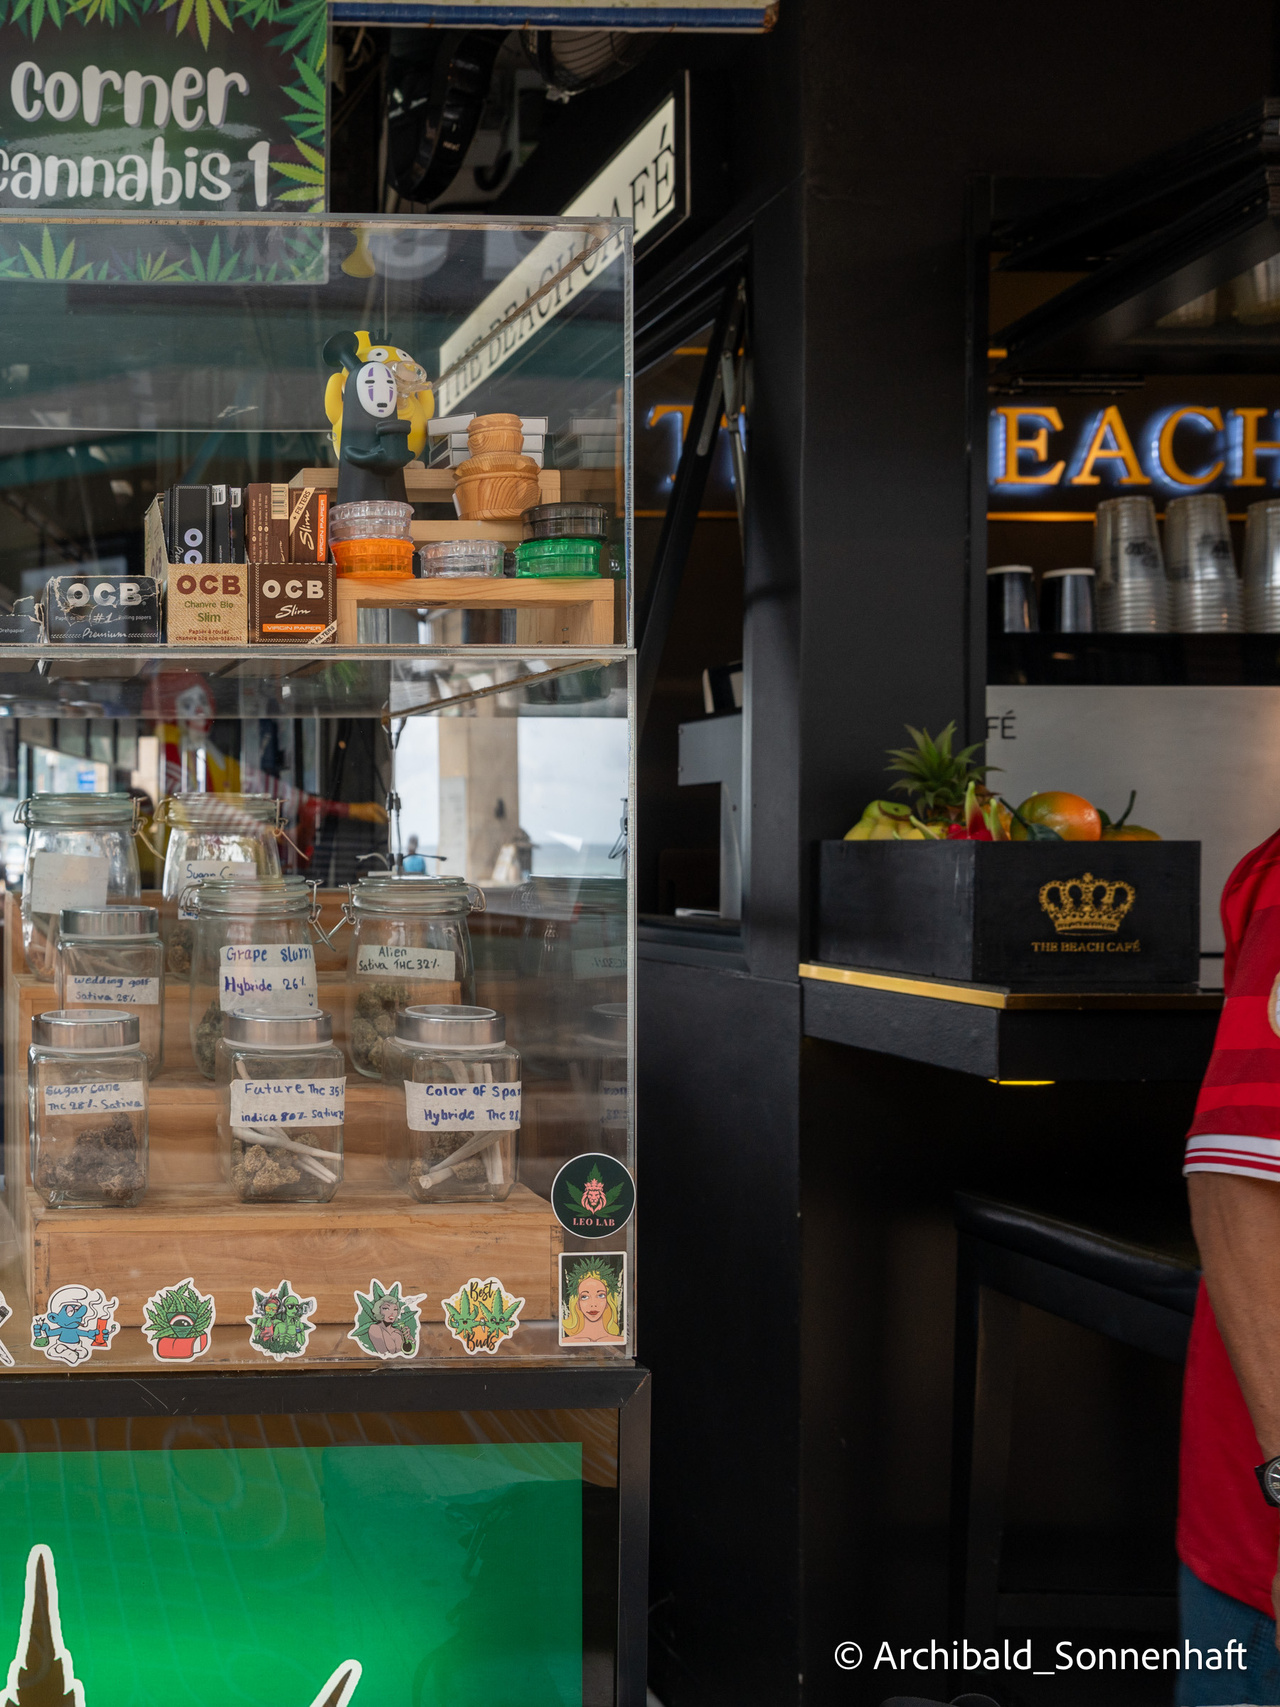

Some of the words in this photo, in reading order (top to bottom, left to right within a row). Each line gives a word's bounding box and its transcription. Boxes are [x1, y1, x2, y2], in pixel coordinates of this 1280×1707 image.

[247, 140, 270, 206] 1
[995, 405, 1280, 486] EACH
[295, 490, 311, 515] FILTERS
[299, 510, 315, 551] Slim
[176, 575, 241, 595] OCB
[262, 579, 324, 599] OCB
[66, 582, 142, 607] OCB
[184, 600, 217, 608] Chanvre
[220, 601, 234, 609] Bio
[275, 604, 311, 619] Slim
[198, 612, 221, 623] Slim
[81, 628, 127, 639] Premium
[315, 625, 336, 643] FILTERS
[226, 947, 267, 962] Grape
[378, 946, 407, 957] Alien
[1031, 942, 1058, 952] THE
[1060, 942, 1105, 952] BEACH
[1106, 939, 1141, 953] CAFÉ
[225, 976, 272, 996] Hybride
[244, 1083, 304, 1095] Future
[426, 1085, 467, 1096] Color
[424, 1109, 475, 1126] Hybride
[572, 1217, 593, 1226] LEO
[595, 1218, 615, 1227] LAB
[469, 1280, 497, 1302] Best
[466, 1334, 498, 1352] Buds
